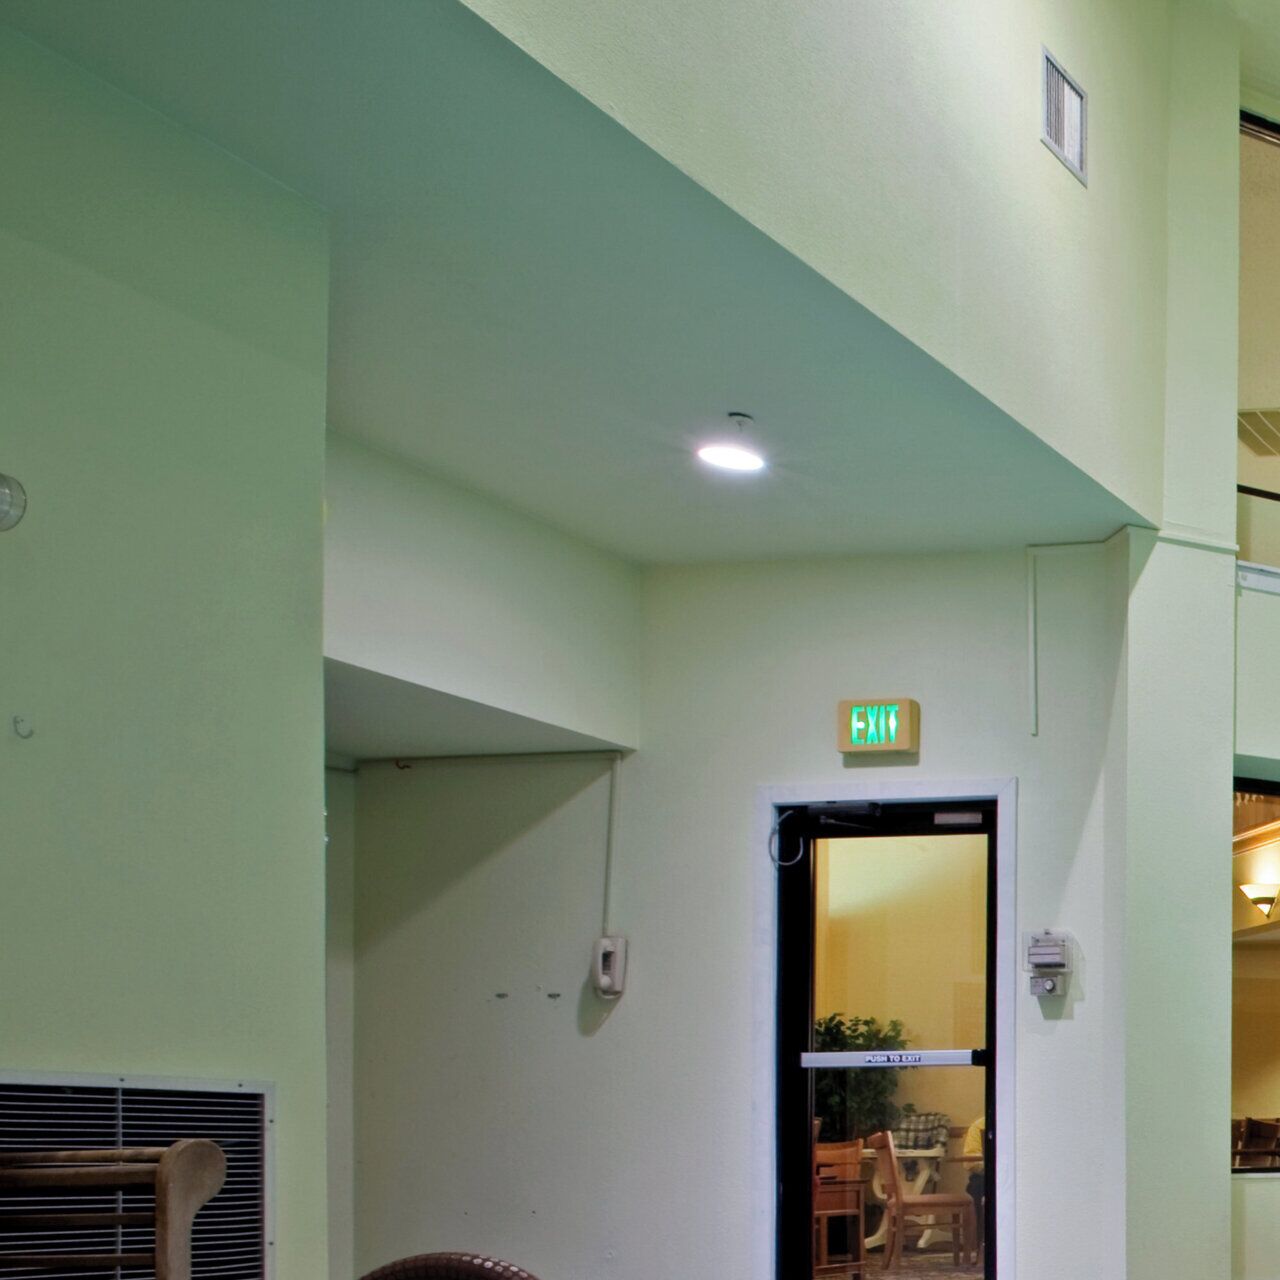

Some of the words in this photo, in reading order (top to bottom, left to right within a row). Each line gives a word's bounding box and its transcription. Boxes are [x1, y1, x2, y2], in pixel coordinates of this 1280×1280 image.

[851, 704, 899, 745] EXIT
[866, 1055, 887, 1063] PUSH
[889, 1055, 900, 1063] TO
[902, 1055, 920, 1063] EXIT
